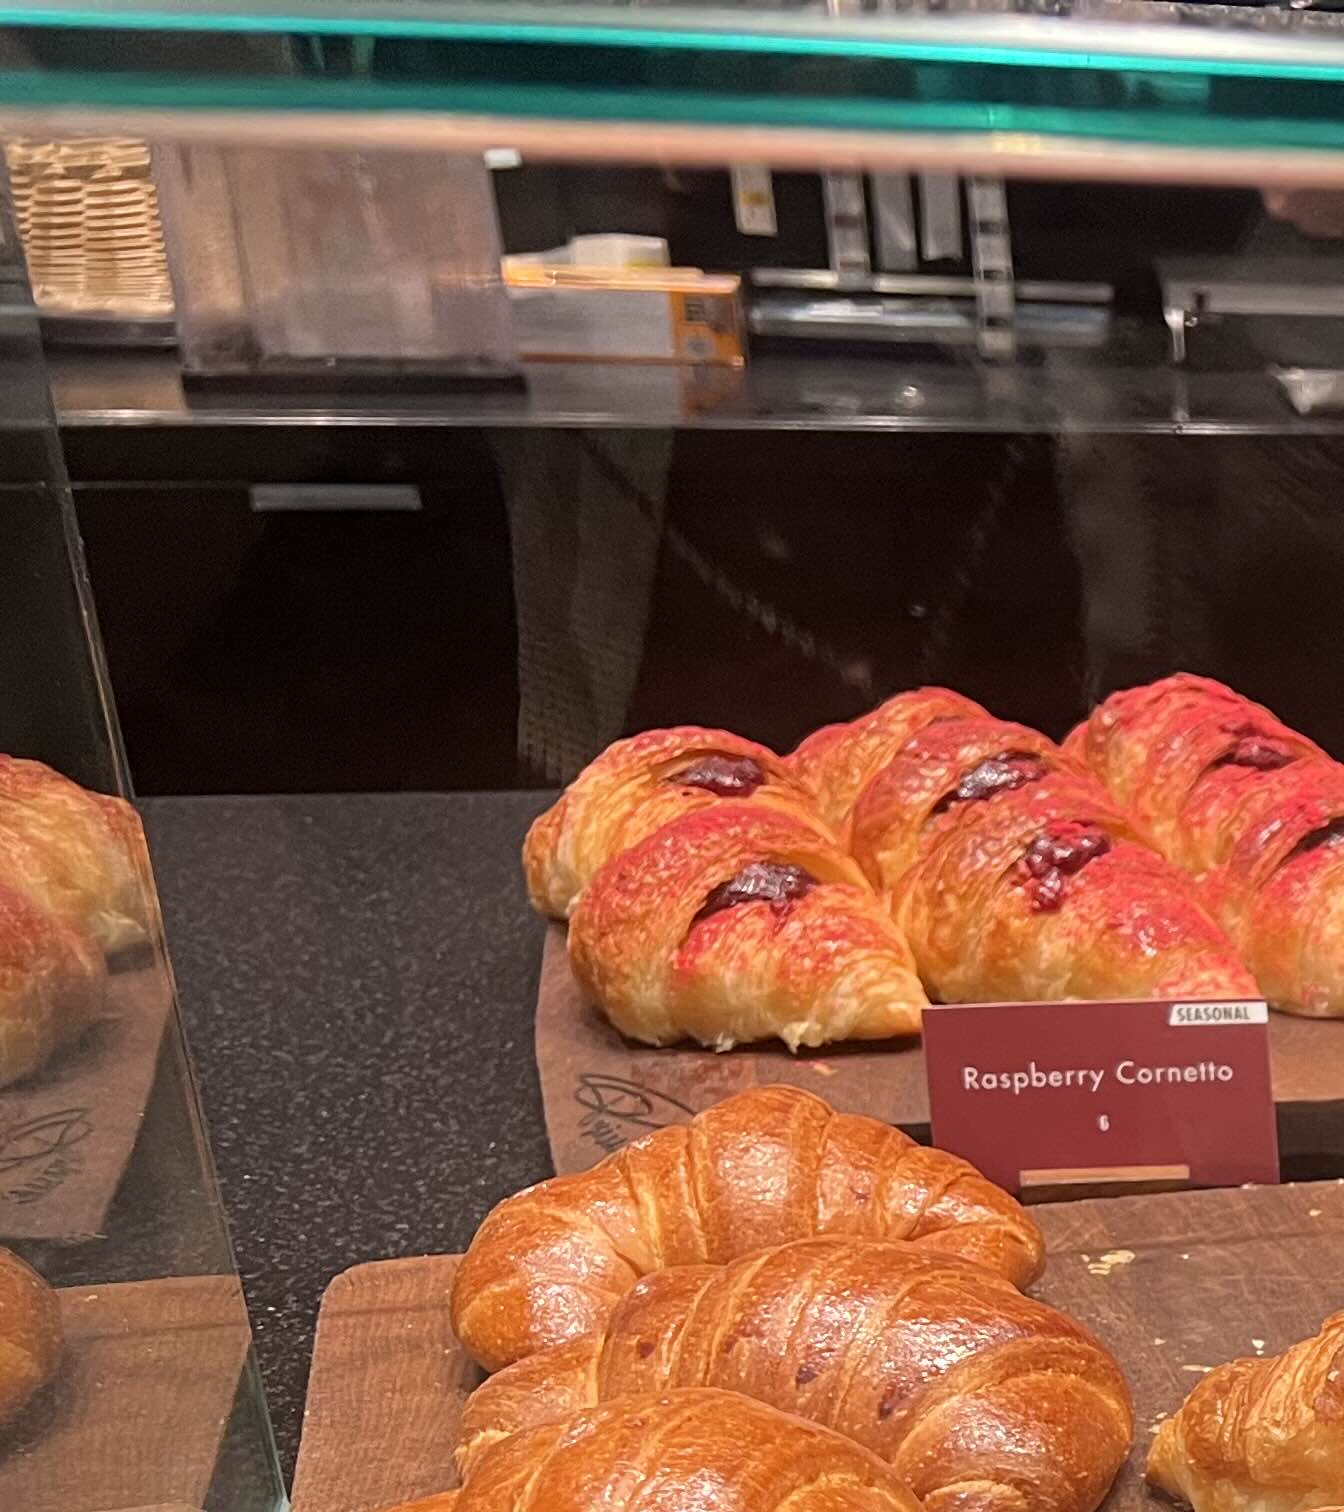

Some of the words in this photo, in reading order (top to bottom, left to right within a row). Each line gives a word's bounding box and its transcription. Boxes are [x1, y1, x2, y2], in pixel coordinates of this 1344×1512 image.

[1176, 1006, 1251, 1022] SEASONAL
[963, 1061, 1105, 1095] Raspberry
[1115, 1060, 1234, 1085] Cornetto
